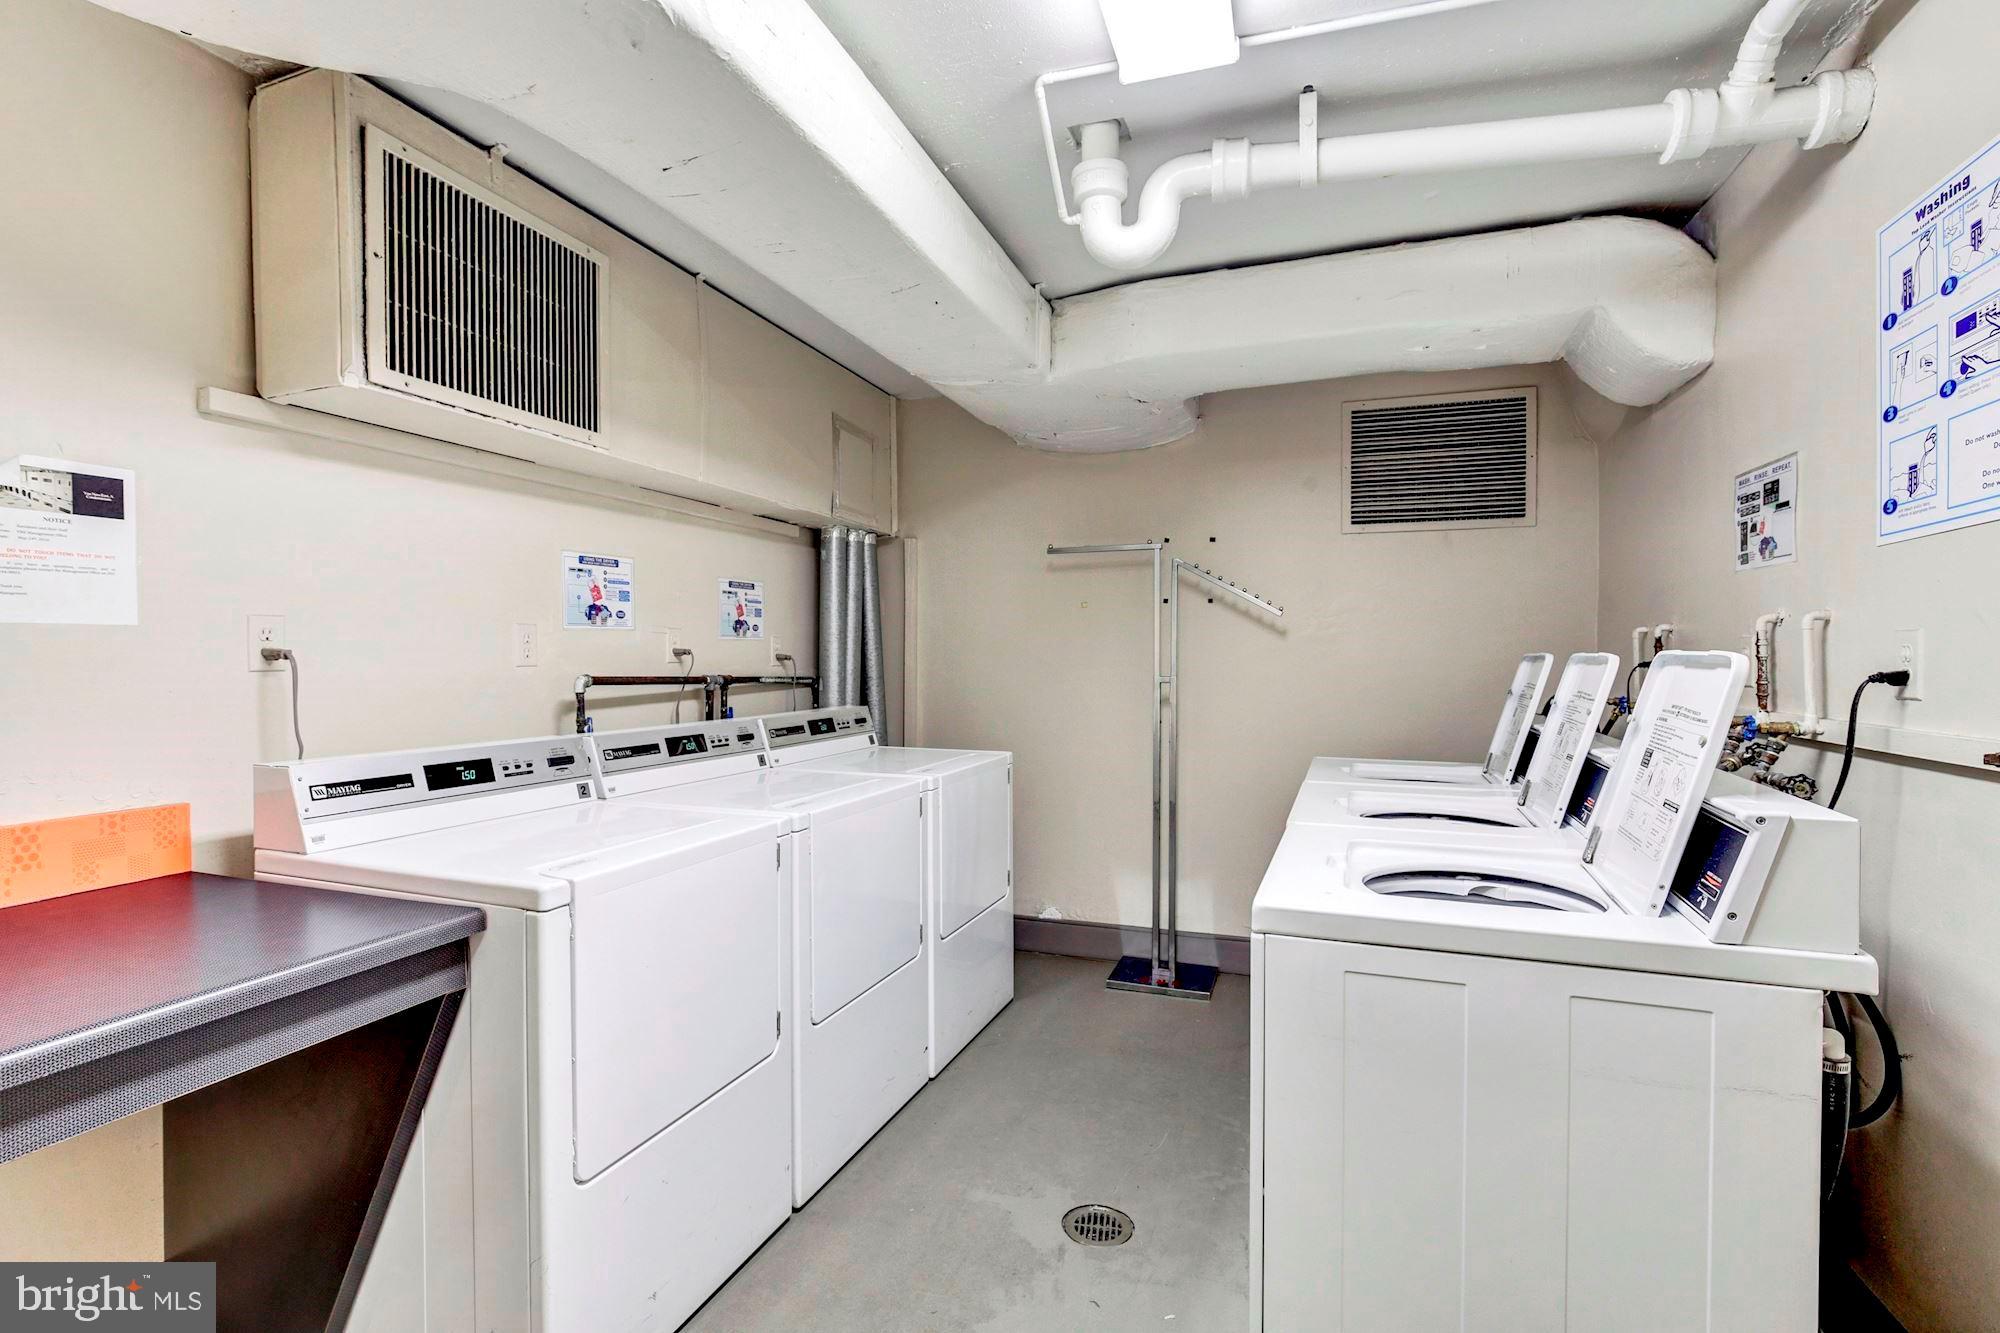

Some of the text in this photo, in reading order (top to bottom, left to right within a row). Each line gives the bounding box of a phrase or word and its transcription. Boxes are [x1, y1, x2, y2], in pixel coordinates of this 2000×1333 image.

[1915, 174, 1971, 223] Washing
[1974, 434, 1985, 443] not
[42, 516, 72, 524] NOTICE
[327, 784, 362, 795] MAYTAG
[580, 785, 587, 796] 2
